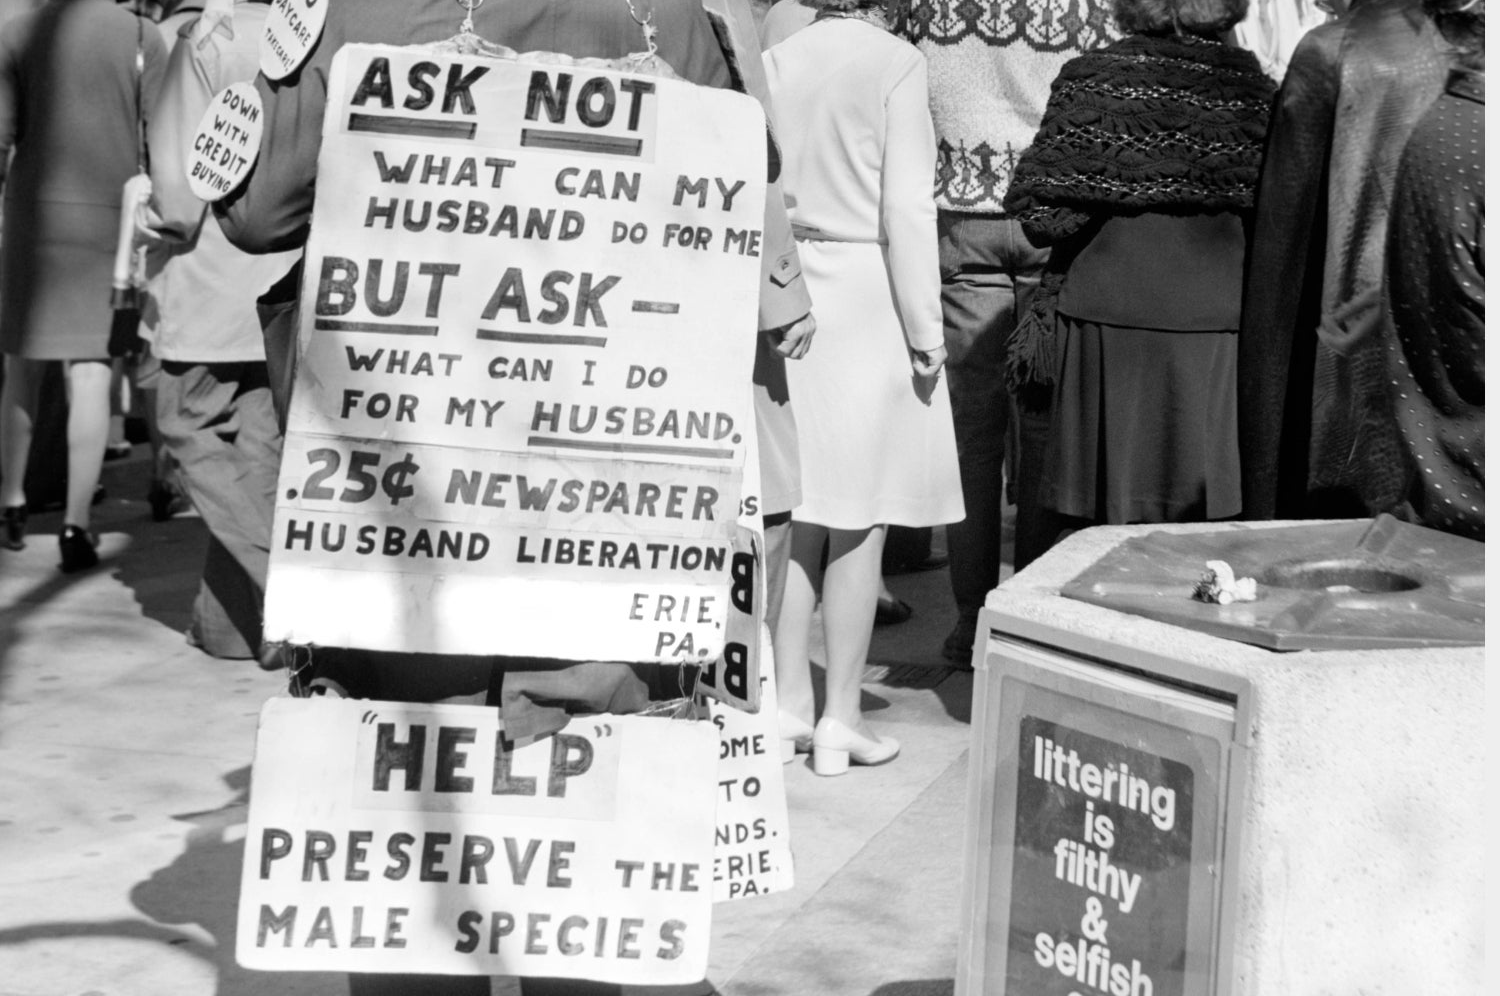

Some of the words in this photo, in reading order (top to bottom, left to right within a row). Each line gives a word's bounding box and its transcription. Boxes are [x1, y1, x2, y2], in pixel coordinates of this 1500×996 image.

[222, 89, 260, 123] DOWN
[350, 56, 491, 115] ASK
[524, 70, 656, 131] NOT
[194, 133, 247, 175] CREDIT
[214, 114, 249, 146] WITH
[191, 161, 231, 193] BUYING
[373, 151, 516, 188] WHAT
[554, 167, 641, 202] CAN
[672, 175, 747, 212] MY
[364, 196, 585, 241] HUSBAND
[611, 220, 648, 244] DO
[663, 223, 712, 251] FOR
[723, 228, 762, 257] ME
[315, 256, 461, 318] BUT
[344, 345, 462, 379] WHAT
[488, 357, 553, 382] CAN
[582, 360, 596, 386] I
[626, 365, 668, 389] DO
[341, 389, 419, 422] FOR
[445, 395, 505, 428] MY
[530, 400, 742, 444] HUSBAND.
[285, 519, 490, 562] HUSBAND
[516, 535, 727, 572] LIBERATION
[655, 631, 711, 658] PA.
[361, 709, 613, 799] "HELP"
[718, 777, 761, 802] TO
[1033, 735, 1176, 832] littering
[1084, 800, 1115, 849] is
[258, 827, 576, 888] PRESERVE
[614, 860, 699, 892] THE
[1054, 838, 1142, 914] filthy
[256, 904, 411, 948] MALE
[454, 910, 688, 960] SPECIES
[1081, 896, 1108, 945] &
[1033, 932, 1154, 996] selfish
